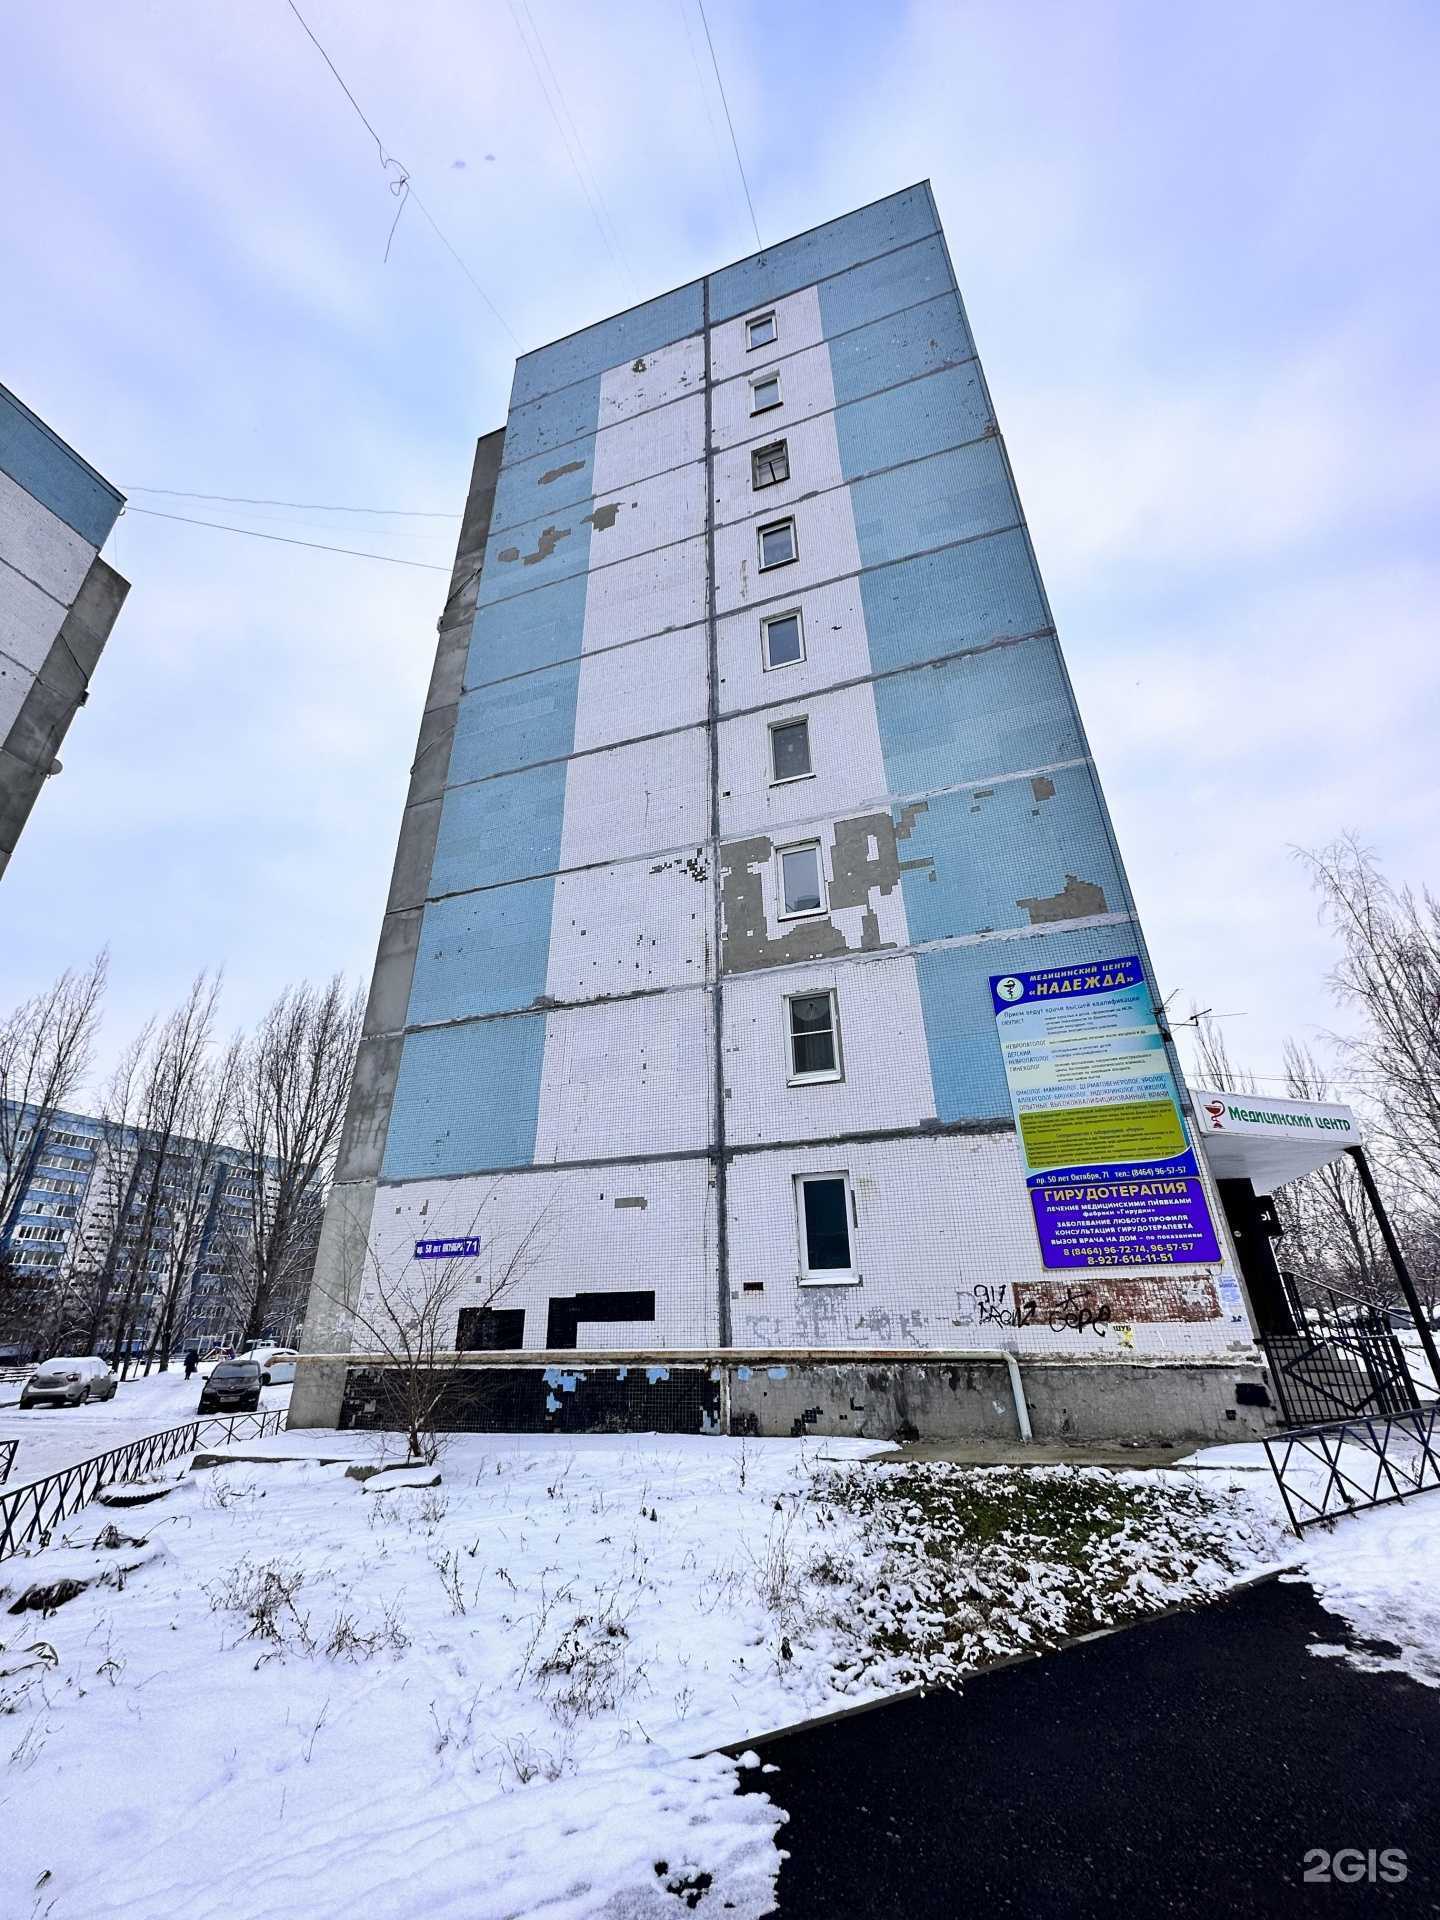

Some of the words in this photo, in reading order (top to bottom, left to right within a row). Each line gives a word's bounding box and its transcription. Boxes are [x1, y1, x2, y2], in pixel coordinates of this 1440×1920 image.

[1029, 966, 1097, 982] МЕДИЦИНСКИЙ
[1102, 961, 1132, 972] ЦЕНТР
[1029, 972, 1134, 996] «НАДЕЖДА»
[1228, 1106, 1313, 1128] Медицинский
[1314, 1117, 1351, 1132] центр
[1047, 1175, 1057, 1183] 50
[1071, 1172, 1101, 1181] Октября,
[1102, 1171, 1109, 1179] 71
[1132, 1168, 1154, 1177] (8464)
[1154, 1166, 1187, 1175] 96-57-57
[1044, 1182, 1187, 1202] ГИРУДОТЕРАПИЯ
[1047, 1204, 1080, 1212] ЛЕЧЕНИЕ
[1081, 1200, 1146, 1211] МЕДИЦИНСКИМИ
[1148, 1198, 1192, 1206] ПИЯВКАМИ
[1057, 1218, 1111, 1228] ЗАБОЛЕВАНИЕ
[1113, 1217, 1147, 1225] ЛЮБОГО
[1149, 1214, 1188, 1222] ПРОФИЛЯ
[1055, 1227, 1116, 1236] КОНСУЛЬТАЦИЯ
[1117, 1223, 1193, 1232] ГИРУДОТЕРАПЕВТА
[466, 1240, 478, 1252] 71
[1079, 1236, 1104, 1244] ВРАЧА
[1063, 1248, 1070, 1256] 8
[1072, 1247, 1102, 1256] (8464)
[1104, 1245, 1149, 1254] 96-72-74,
[1150, 1242, 1194, 1252] 96-57-57
[1087, 1253, 1174, 1265] 8-927-614-11-51
